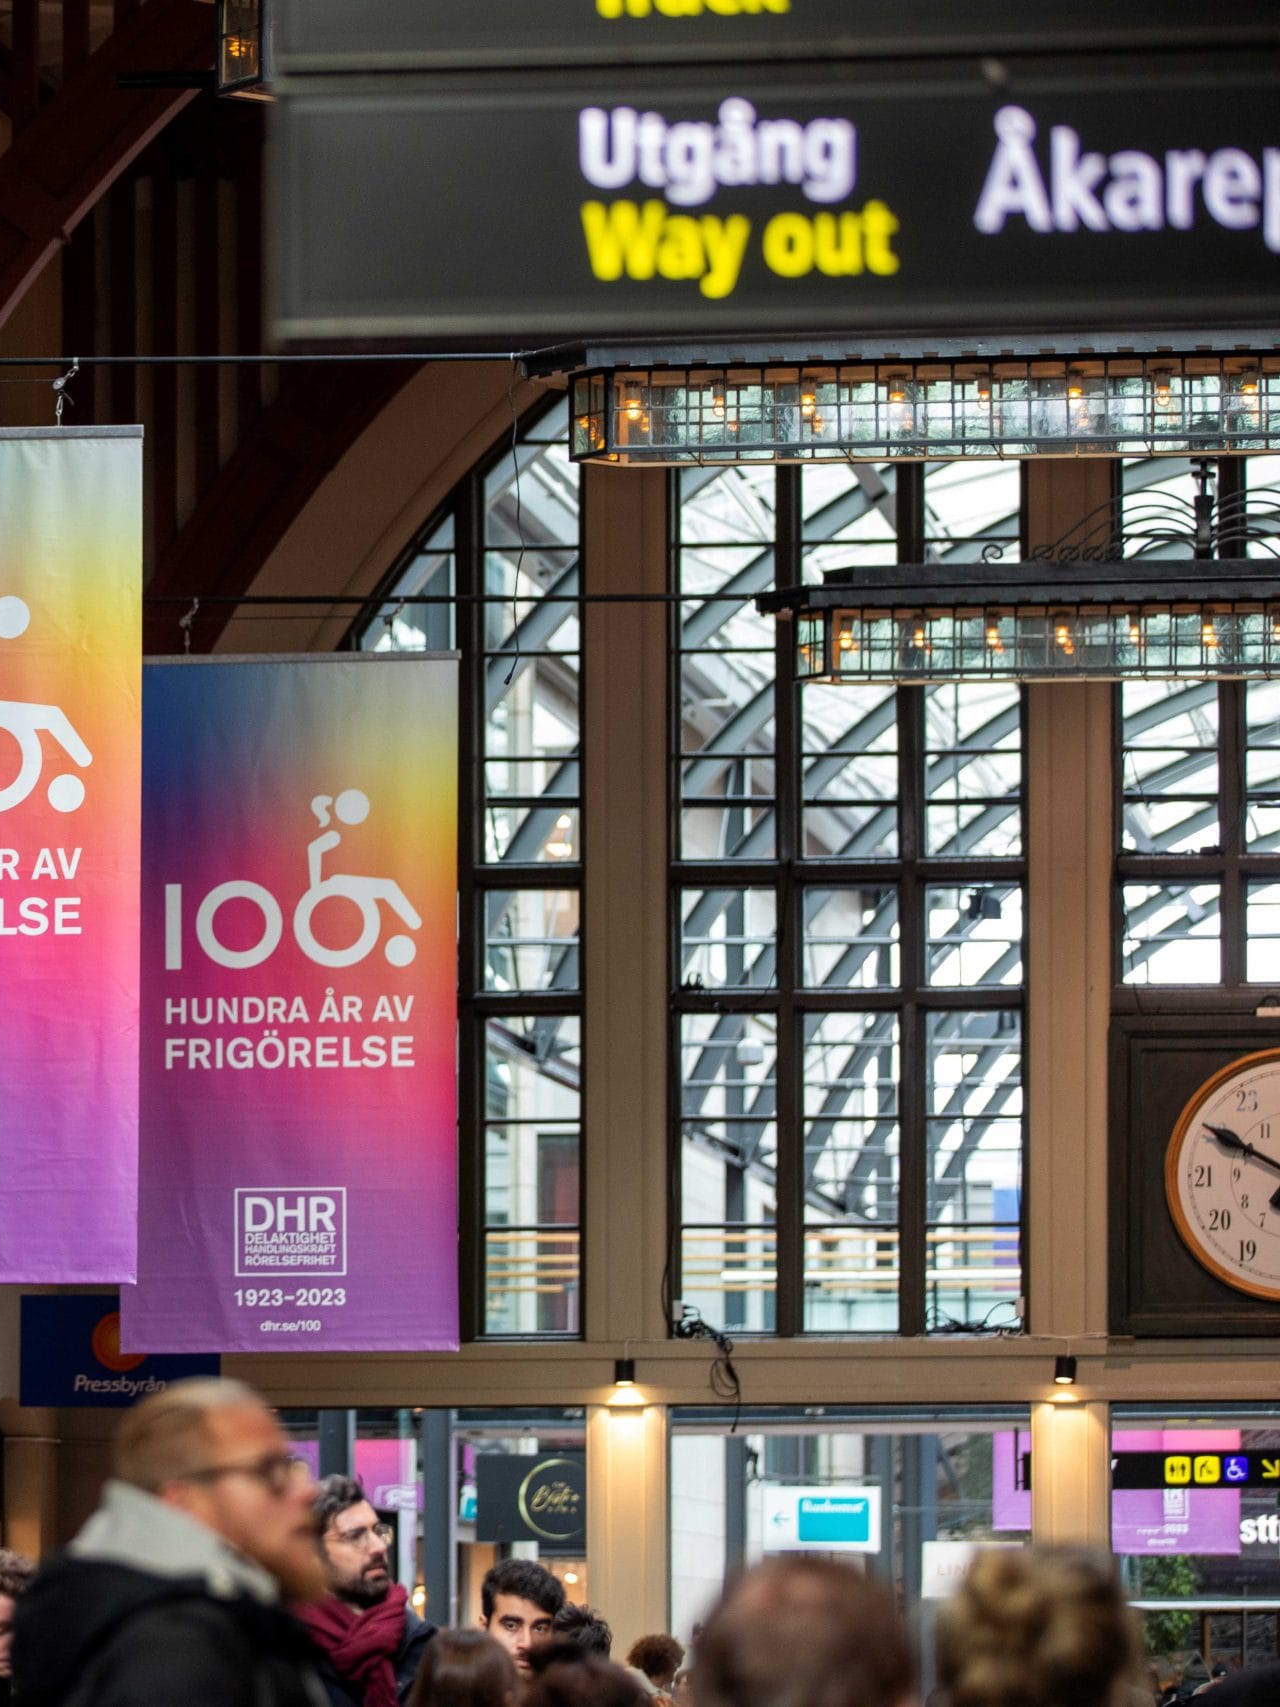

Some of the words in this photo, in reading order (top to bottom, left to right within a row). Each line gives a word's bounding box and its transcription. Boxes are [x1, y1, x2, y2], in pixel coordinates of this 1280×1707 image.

[578, 96, 856, 206] Utgång
[973, 104, 1280, 254] Åkare
[581, 199, 751, 299] Way
[762, 199, 900, 278] out
[31, 848, 82, 880] AV
[165, 880, 381, 970] 100
[165, 996, 309, 1024] HUNDRA
[318, 987, 363, 1023] ÅR
[372, 995, 414, 1023] AV
[165, 1029, 415, 1070] FRIGÖRELSE
[1236, 1090, 1258, 1112] 23
[1260, 1123, 1271, 1139] 11
[1194, 1165, 1213, 1188] 21
[1233, 1168, 1240, 1183] 9
[1241, 1194, 1249, 1209] 8
[244, 1196, 336, 1232] DHR
[1208, 1208, 1231, 1231] 20
[1258, 1212, 1266, 1228] 7
[244, 1232, 336, 1244] DELAKTIGHET
[244, 1244, 336, 1254] HANDLINGSKRAFT
[244, 1254, 336, 1266] RÖRELSEFRIHET
[1239, 1239, 1256, 1262] 19
[260, 1319, 321, 1332] dhr.se/100
[73, 1374, 166, 1397] Pressbyrån
